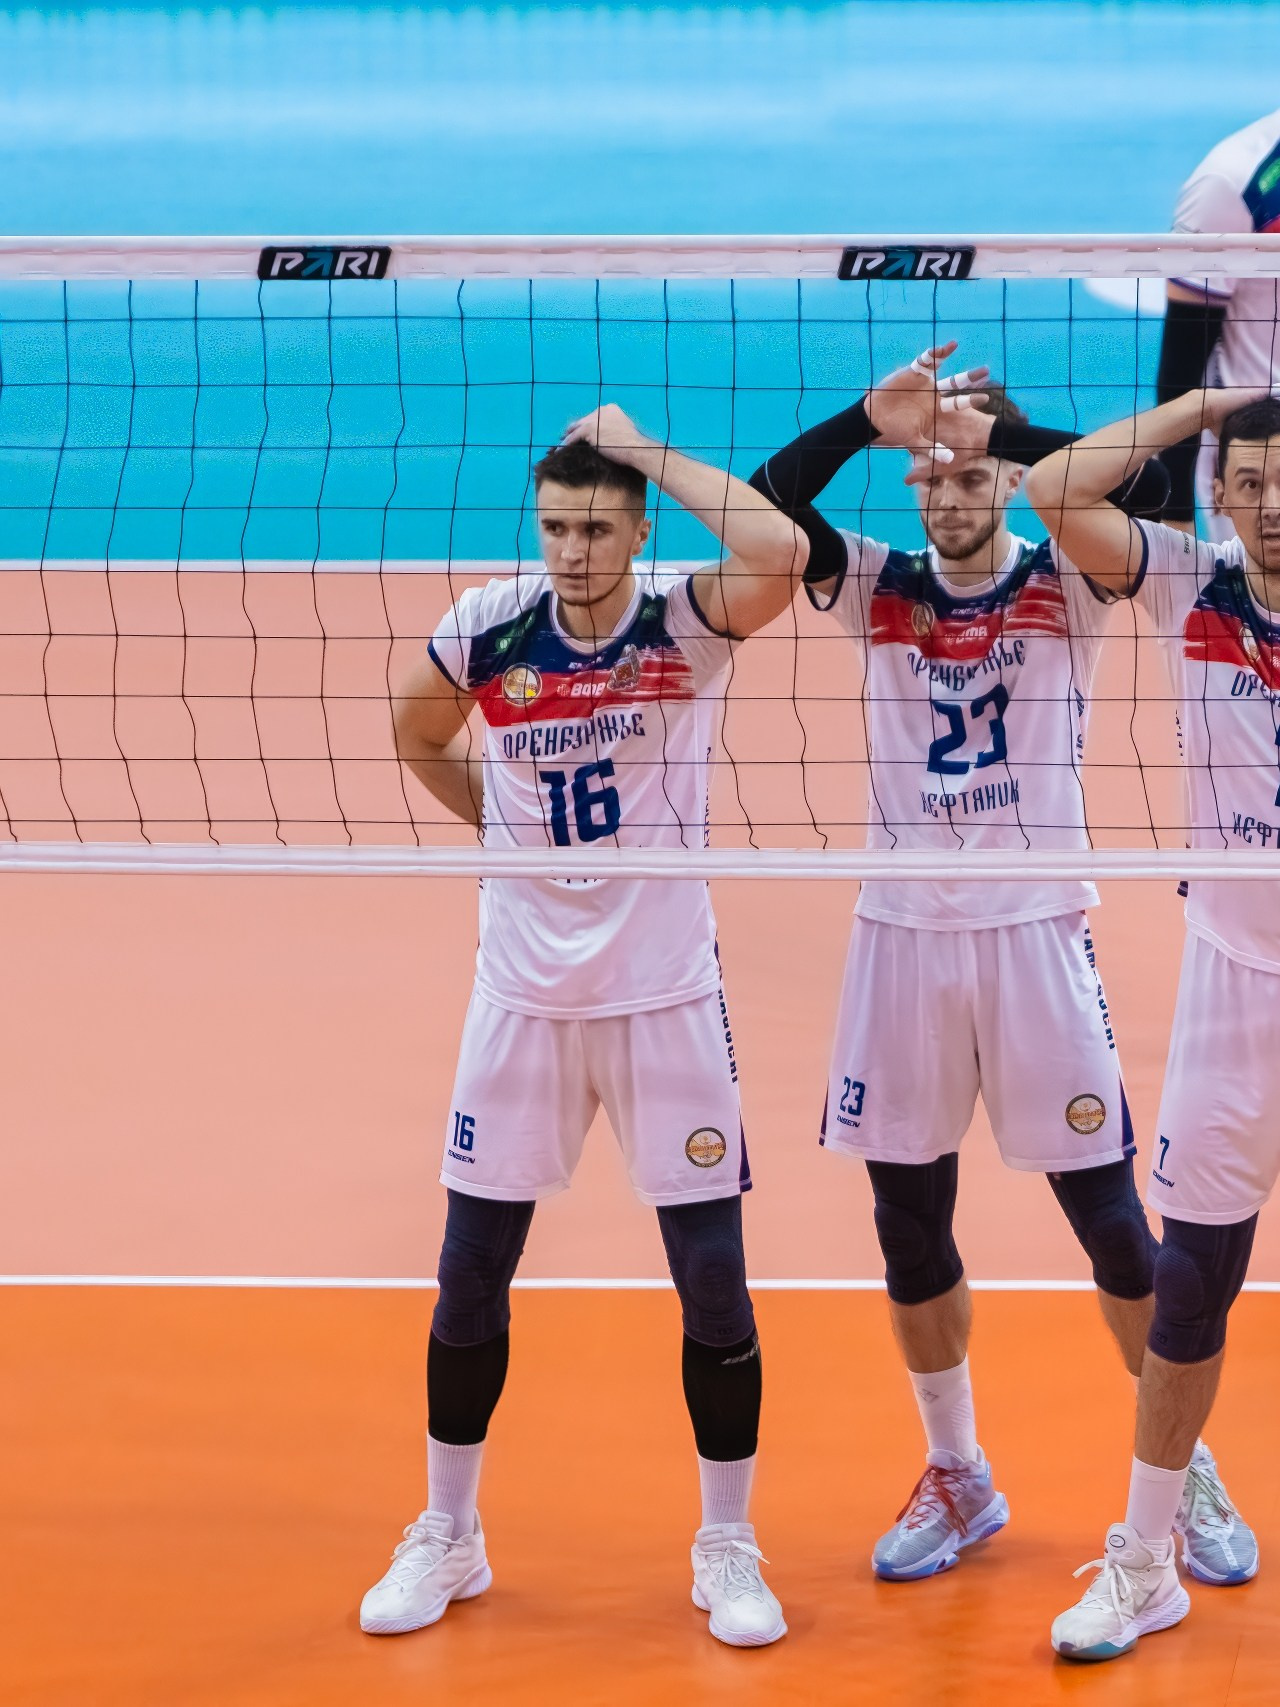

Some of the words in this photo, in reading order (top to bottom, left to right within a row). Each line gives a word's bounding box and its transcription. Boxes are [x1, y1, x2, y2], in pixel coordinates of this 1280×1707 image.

[270, 251, 380, 277] PARI
[850, 251, 962, 277] PARI
[927, 683, 1009, 775] 23
[539, 757, 622, 847] 16
[839, 1075, 866, 1117] 23
[453, 1110, 476, 1152] 16
[1159, 1134, 1170, 1171] 7
